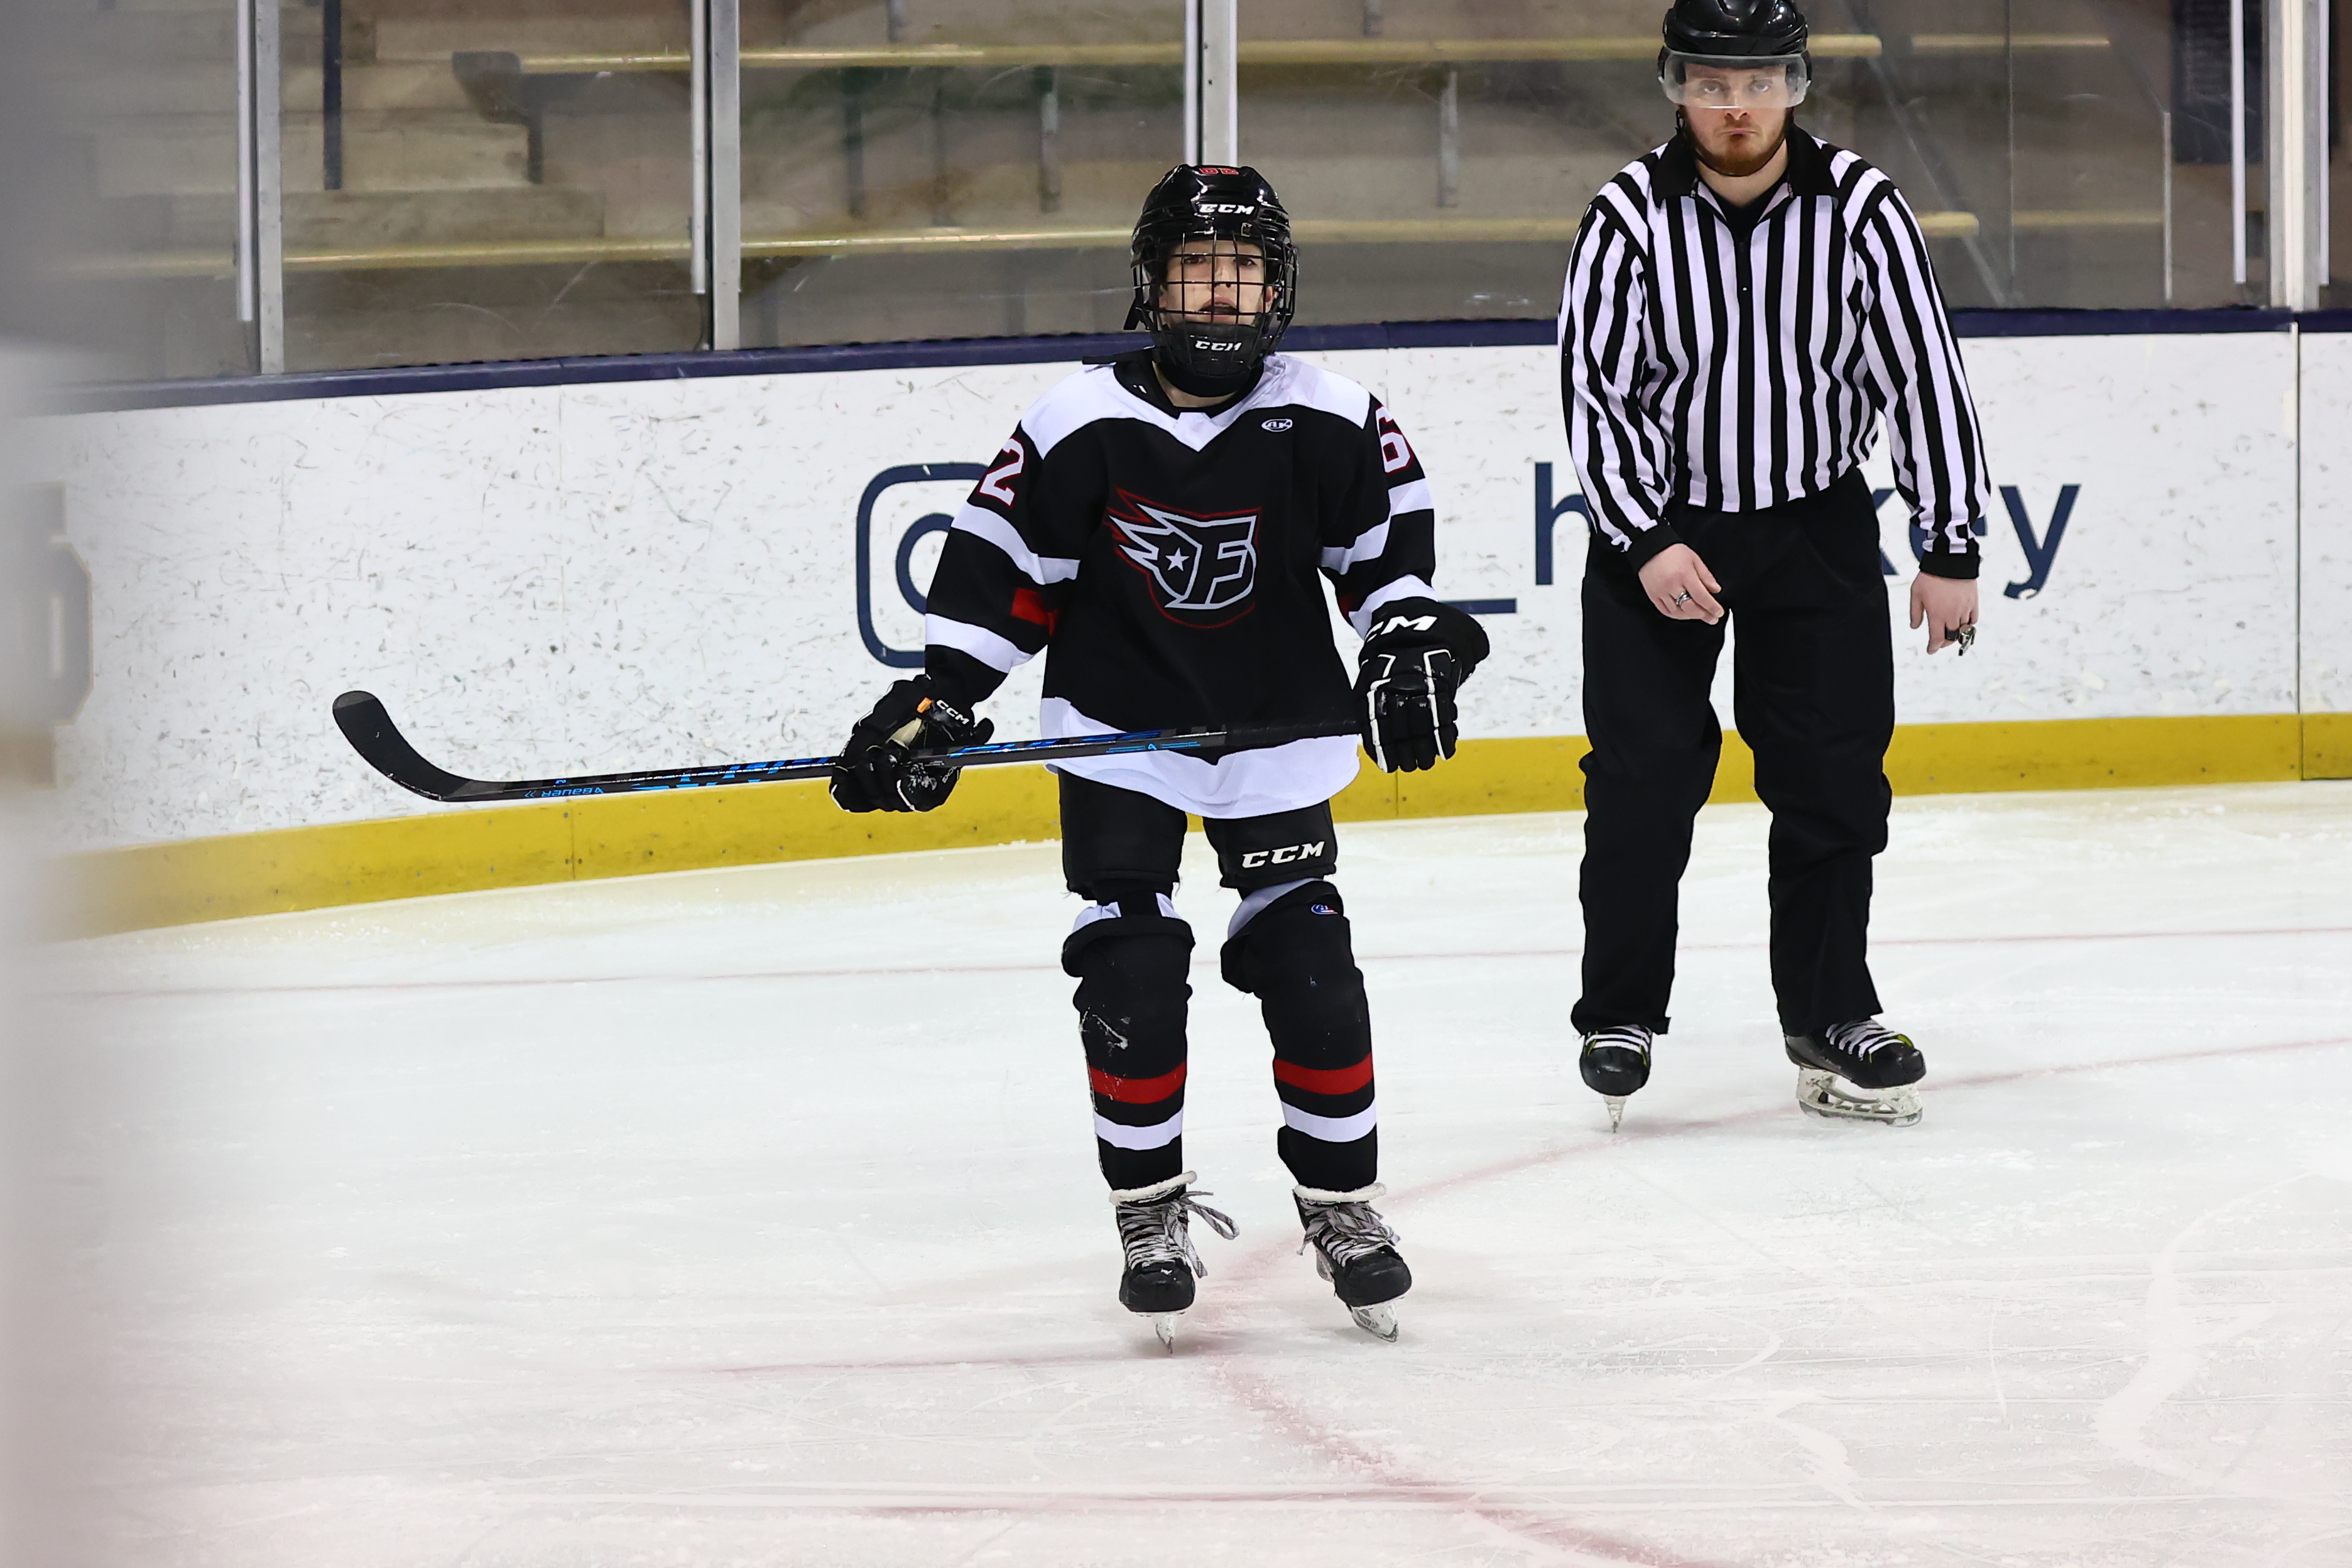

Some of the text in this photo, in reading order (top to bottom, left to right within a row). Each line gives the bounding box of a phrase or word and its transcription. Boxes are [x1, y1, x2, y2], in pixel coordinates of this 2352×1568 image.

[1199, 204, 1255, 215] CCM
[1195, 340, 1243, 351] CCM
[978, 436, 1026, 508] 2
[1364, 615, 1438, 643] CM
[936, 699, 970, 725] CCM
[1241, 841, 1325, 869] CCM
